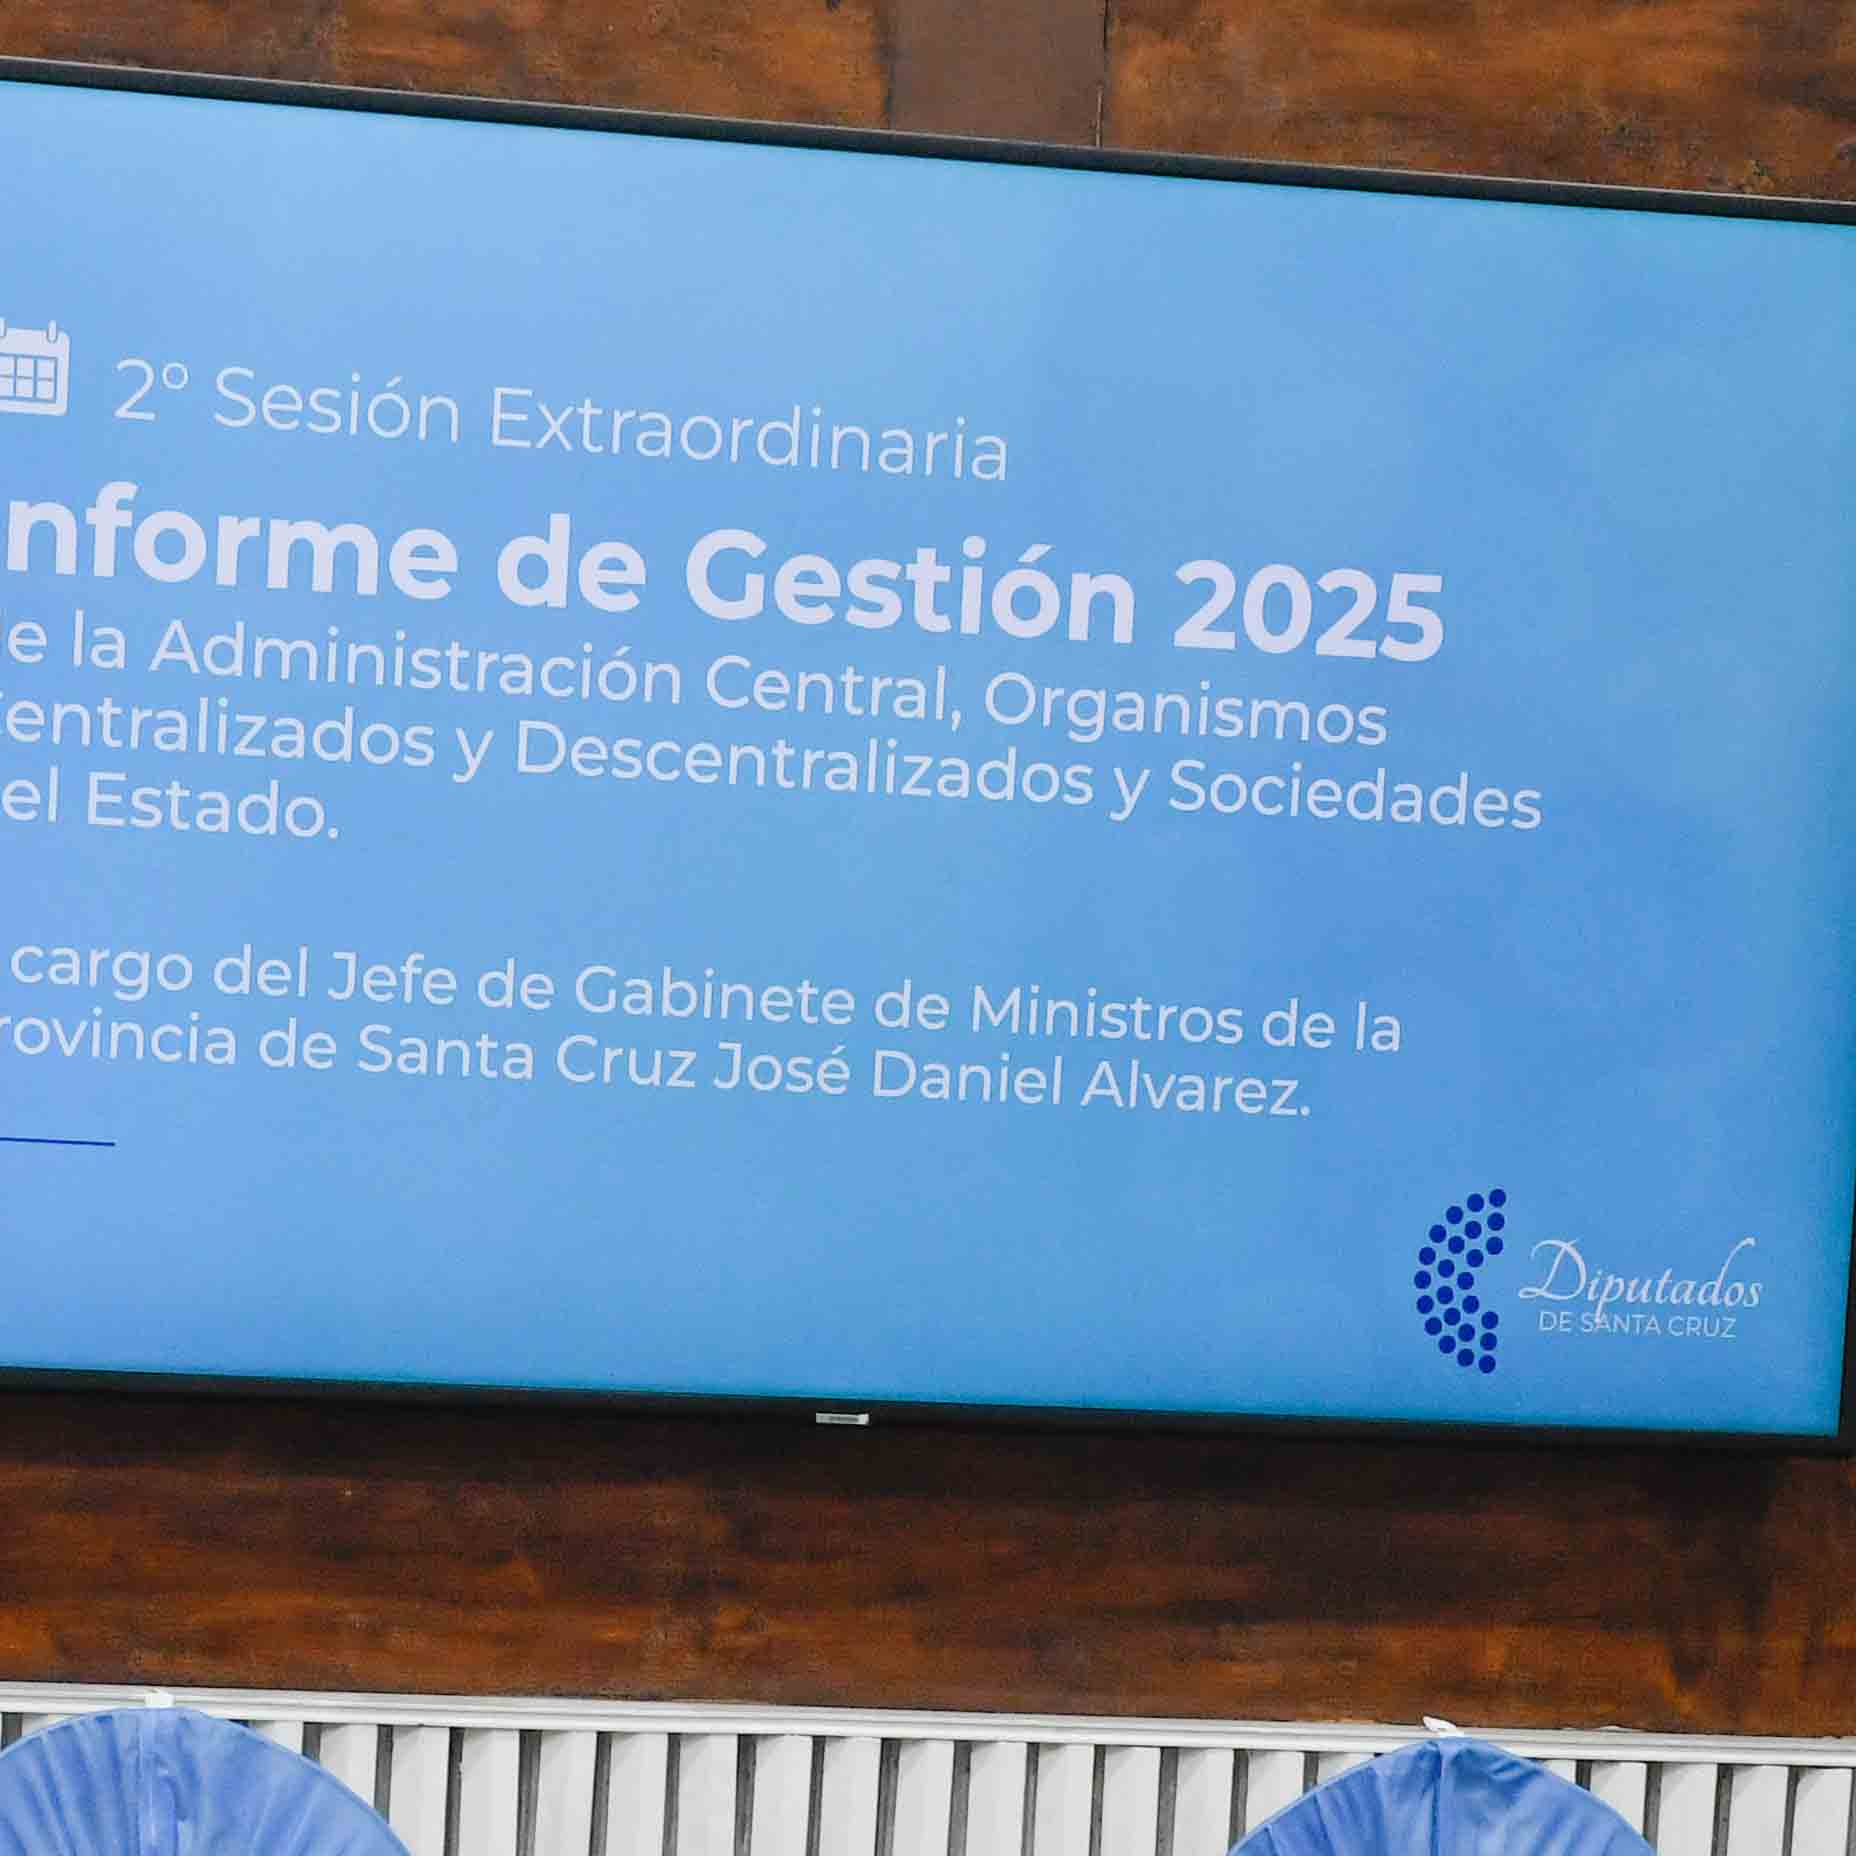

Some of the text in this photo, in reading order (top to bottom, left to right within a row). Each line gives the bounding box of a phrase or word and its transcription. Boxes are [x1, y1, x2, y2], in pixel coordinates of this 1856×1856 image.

[213, 366, 459, 443] Sesión
[491, 386, 1008, 481] Extraordinaria
[497, 512, 647, 613] de
[686, 528, 1135, 645] Gestión
[1173, 559, 1444, 662] 2025
[72, 607, 126, 670] la
[148, 619, 681, 706] Administración
[706, 654, 962, 732] Central,
[984, 671, 1388, 746] Organismos
[87, 771, 339, 840] Estado.
[452, 727, 495, 784] y
[517, 718, 1094, 805] Descentralizados
[1109, 767, 1152, 822] y
[1168, 759, 1542, 830] Sociedades
[10, 945, 193, 1002] cargo
[213, 943, 309, 997] del
[327, 951, 457, 1005] Jefe
[477, 957, 555, 1010] de
[575, 964, 855, 1025] Gabinete
[874, 978, 951, 1030] de
[972, 983, 1244, 1045] Ministros
[1262, 997, 1337, 1049] de
[1355, 1000, 1401, 1053] la
[258, 1016, 337, 1070] de
[356, 1023, 534, 1081] Santa
[556, 1034, 697, 1089] Cruz
[712, 1041, 851, 1095] José
[872, 1048, 1063, 1105] Daniel
[1079, 1058, 1311, 1117] Alvarez.
[1518, 1237, 1763, 1328] Diputados
[1538, 1311, 1737, 1339] DE SANTA CRUZ
